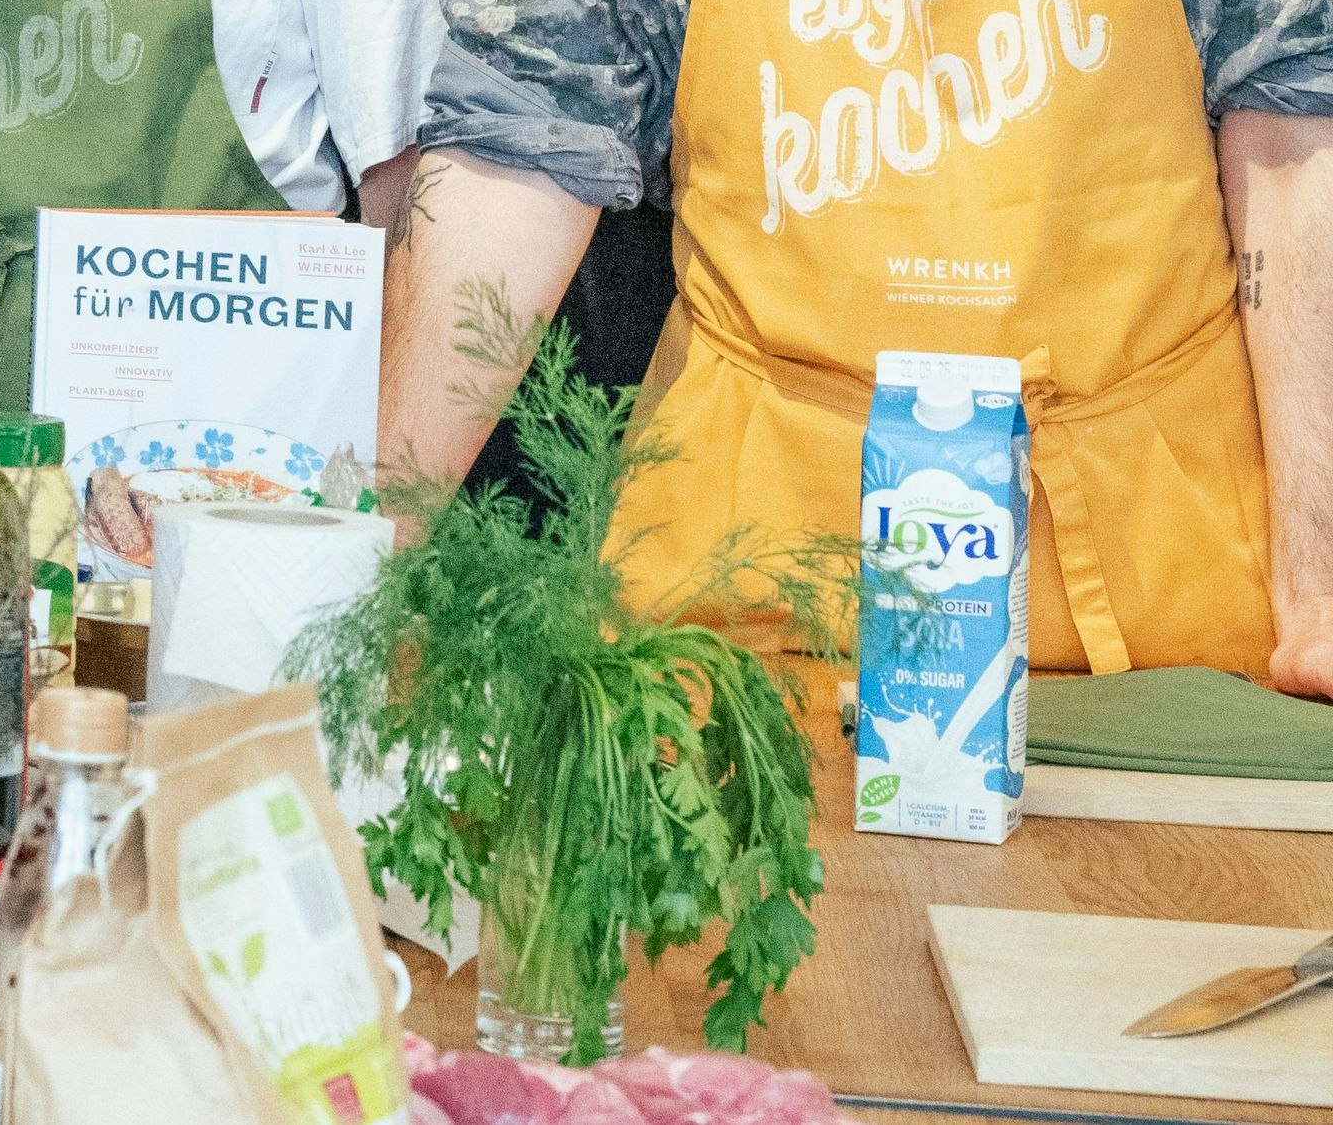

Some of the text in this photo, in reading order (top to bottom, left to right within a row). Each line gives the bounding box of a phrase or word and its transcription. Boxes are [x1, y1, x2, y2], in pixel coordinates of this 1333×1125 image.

[298, 243, 366, 256] Karl & Leo
[76, 244, 268, 285] KOCHEN
[298, 262, 366, 275] WRENKH
[886, 256, 1012, 281] WRENKH
[886, 292, 1018, 307] WIENER KOCHSALON
[73, 286, 353, 331] für MORGEN
[71, 341, 160, 355] UNKOMPLIZIERT
[114, 366, 173, 378] INNOVATIV
[68, 386, 145, 398] PLANT-BASED
[902, 497, 975, 510] TASTE THE JOY
[877, 506, 999, 570] Joya
[895, 668, 965, 688] 0% SUGAR
[863, 777, 894, 799] PLANT
[869, 786, 896, 803] BASED
[908, 810, 948, 820] VITAMINS
